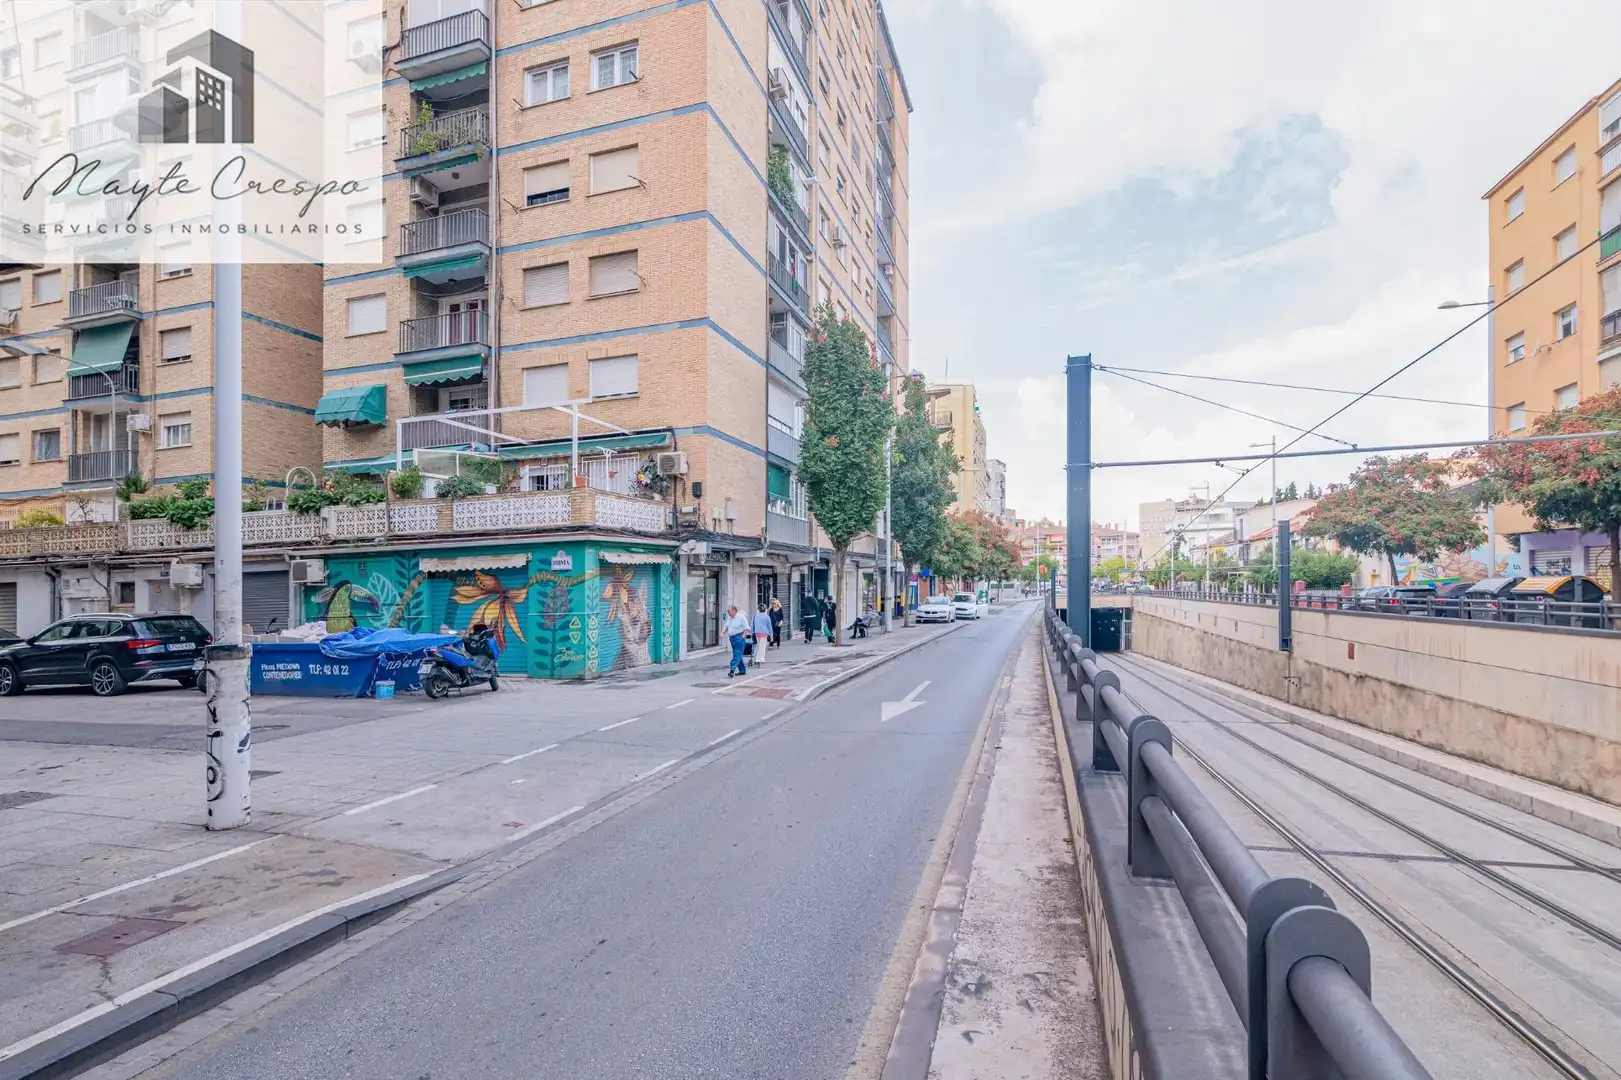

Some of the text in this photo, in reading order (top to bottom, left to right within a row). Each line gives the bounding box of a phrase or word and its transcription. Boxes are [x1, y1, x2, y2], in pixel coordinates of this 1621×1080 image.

[323, 664, 331, 675] 42
[332, 665, 340, 675] 01
[340, 665, 349, 675] 22
